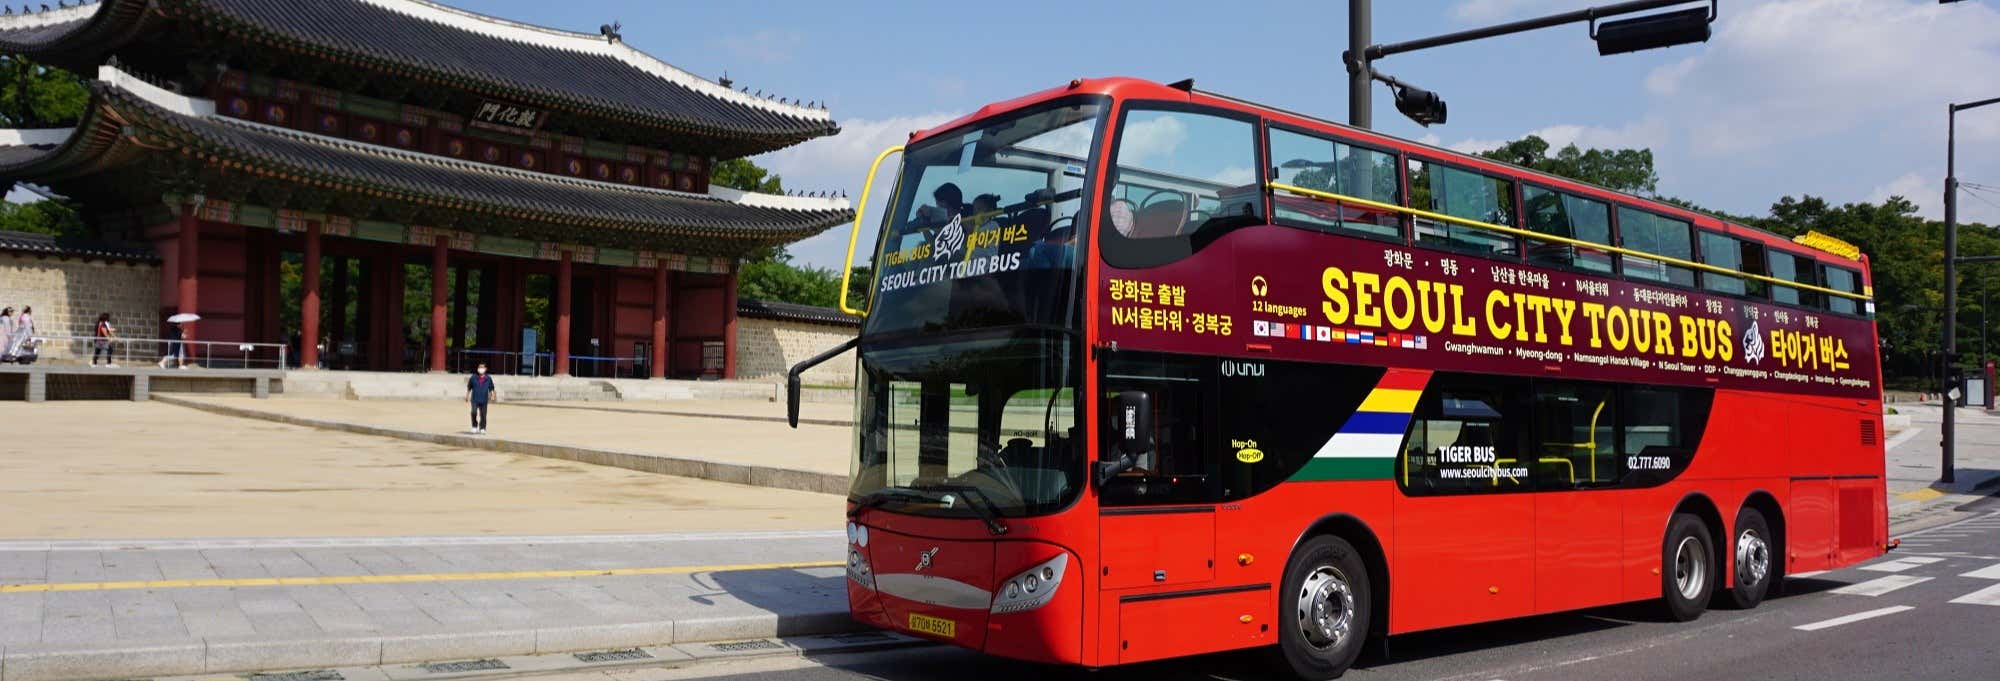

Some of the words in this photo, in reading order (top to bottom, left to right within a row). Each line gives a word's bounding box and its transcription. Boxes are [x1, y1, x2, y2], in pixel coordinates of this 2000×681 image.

[1002, 224, 1028, 245] 버스
[885, 250, 909, 267] TIGER
[911, 243, 931, 262] BUS
[880, 269, 916, 292] SEOUL
[919, 264, 948, 284] CITY
[950, 257, 986, 280] TOUR
[989, 251, 1021, 273] BUS
[1384, 249, 1414, 270] 광화문
[1440, 257, 1458, 277] 명동
[1491, 265, 1516, 285] 남산골
[1518, 269, 1550, 290] 한옥마을
[1575, 279, 1609, 297] N서울타워
[1109, 278, 1154, 303] 광화문
[1158, 283, 1186, 307] 출발
[1252, 300, 1263, 312] 12
[1264, 301, 1307, 319] languages
[1322, 266, 1477, 336] SEOUL
[1485, 289, 1576, 346] CITY
[1582, 302, 1675, 356] TOUR
[1679, 315, 1733, 362] BUS
[1445, 340, 1503, 356] Gwanghwamun
[1516, 346, 1563, 362] Myeong-dong
[1574, 352, 1609, 366] Namsangol
[1609, 355, 1629, 366] Hanok
[1630, 356, 1650, 370] Village
[1658, 360, 1664, 370] N
[1664, 361, 1680, 371] Seoul
[1680, 362, 1696, 373] Tower
[1704, 364, 1717, 374] DDP
[1770, 328, 1818, 371] 타이거
[1819, 335, 1850, 372] 버스
[1231, 438, 1257, 449] Hop-On
[1439, 446, 1472, 463] TIGER
[1473, 446, 1496, 463] BUS
[1238, 452, 1262, 461] Hop-Off
[1627, 456, 1671, 469] 02.777.6090
[1440, 465, 1528, 479] www.seoulcitybus.com
